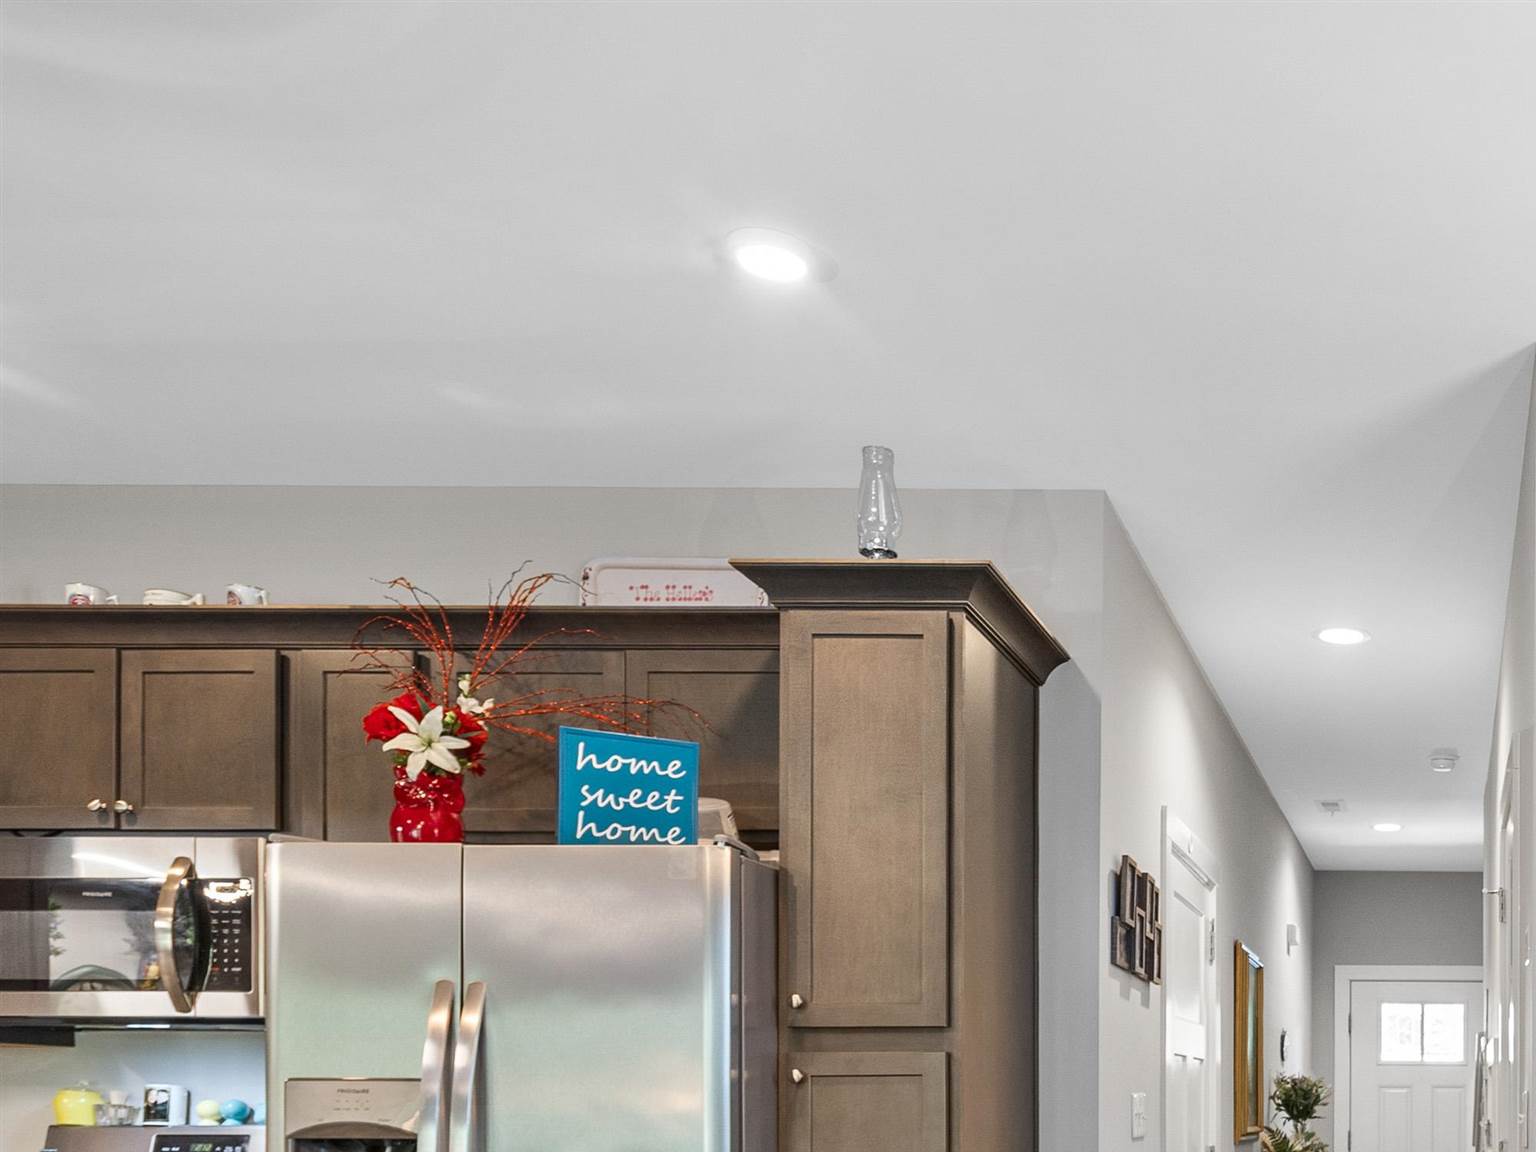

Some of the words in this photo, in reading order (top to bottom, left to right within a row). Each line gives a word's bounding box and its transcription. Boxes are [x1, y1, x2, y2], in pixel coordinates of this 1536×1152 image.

[575, 741, 687, 779] home
[580, 784, 684, 814] sweet
[575, 810, 687, 845] home
